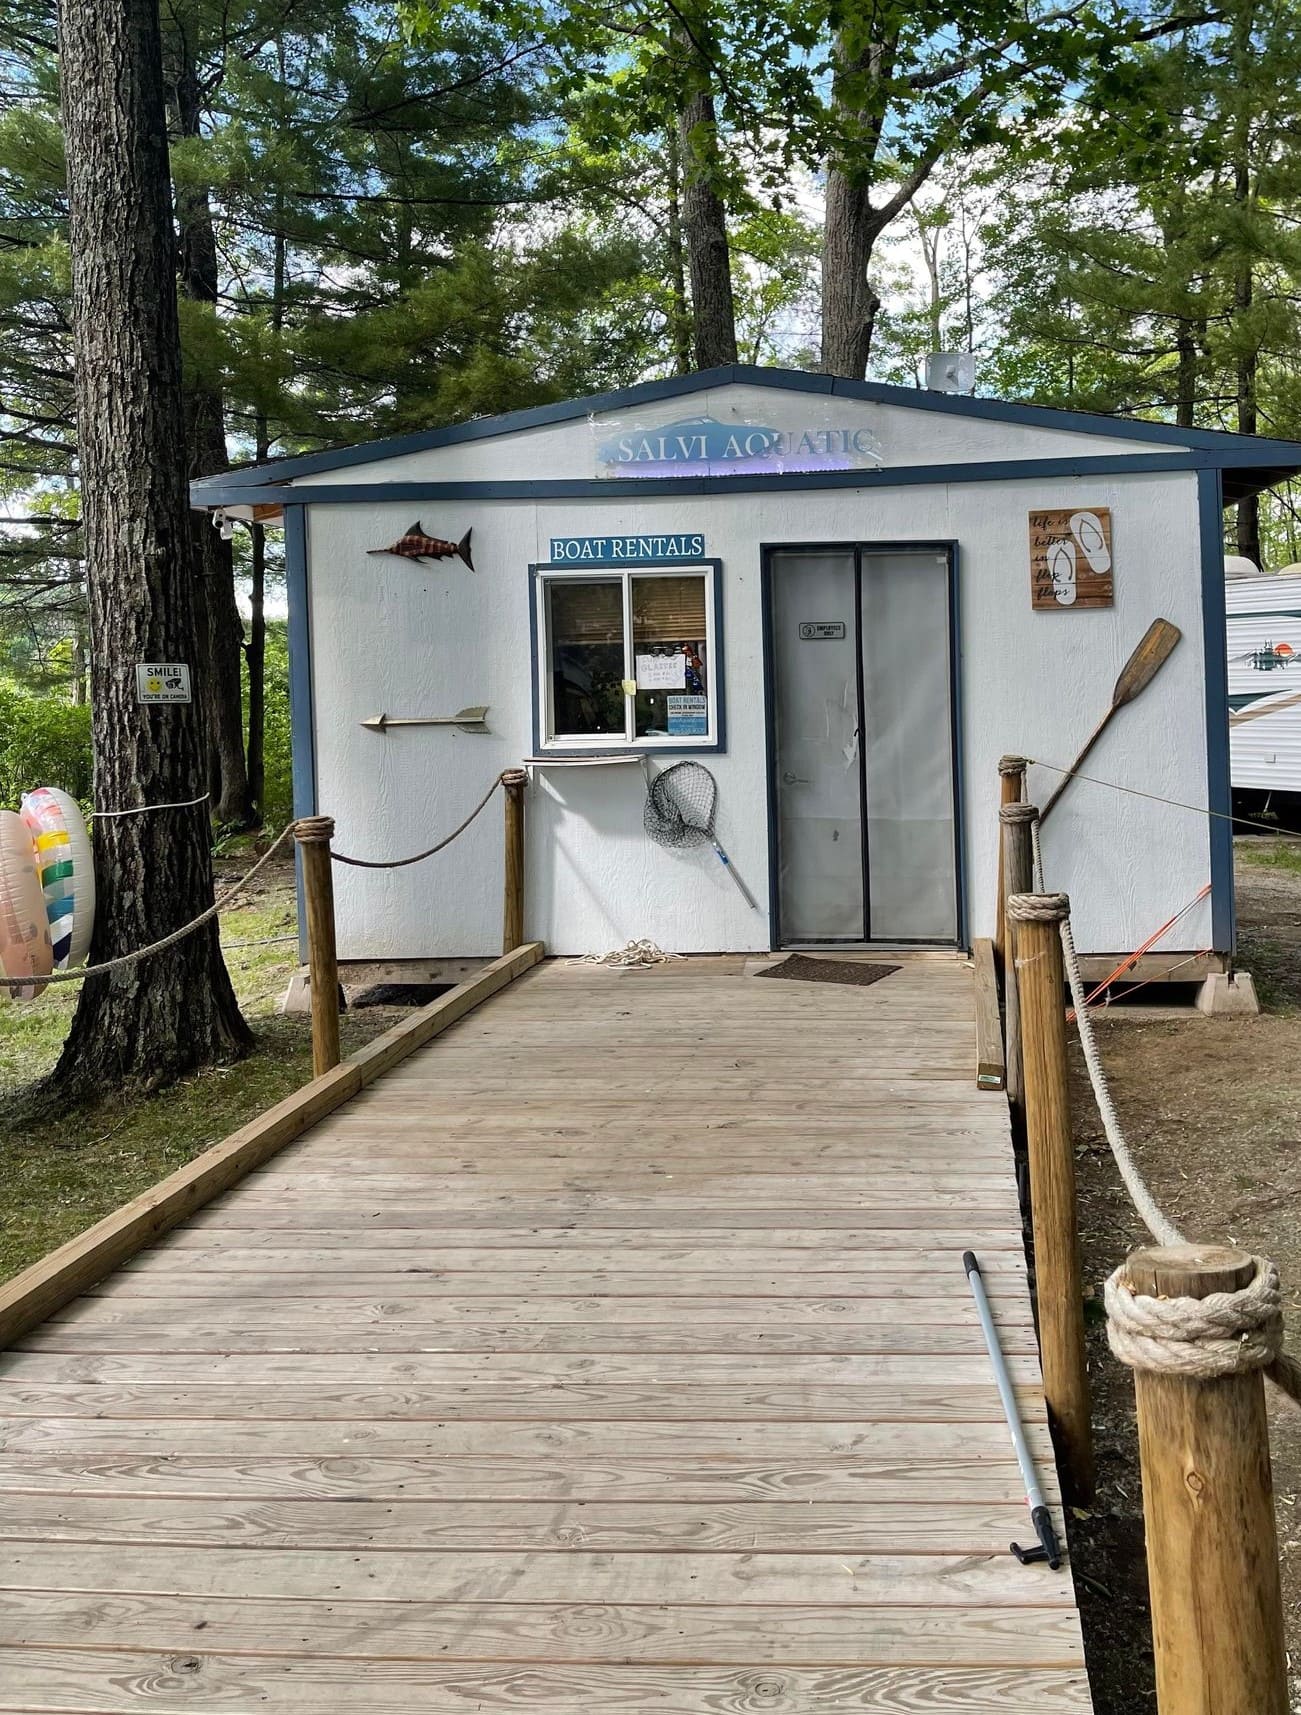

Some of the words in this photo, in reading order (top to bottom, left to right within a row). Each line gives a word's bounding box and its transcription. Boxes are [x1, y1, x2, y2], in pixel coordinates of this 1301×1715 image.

[618, 434, 708, 463] SALVI
[721, 428, 874, 458] AQUATIC
[553, 540, 606, 560] BOAT
[612, 537, 702, 557] RENTALS
[1034, 535, 1068, 547] better
